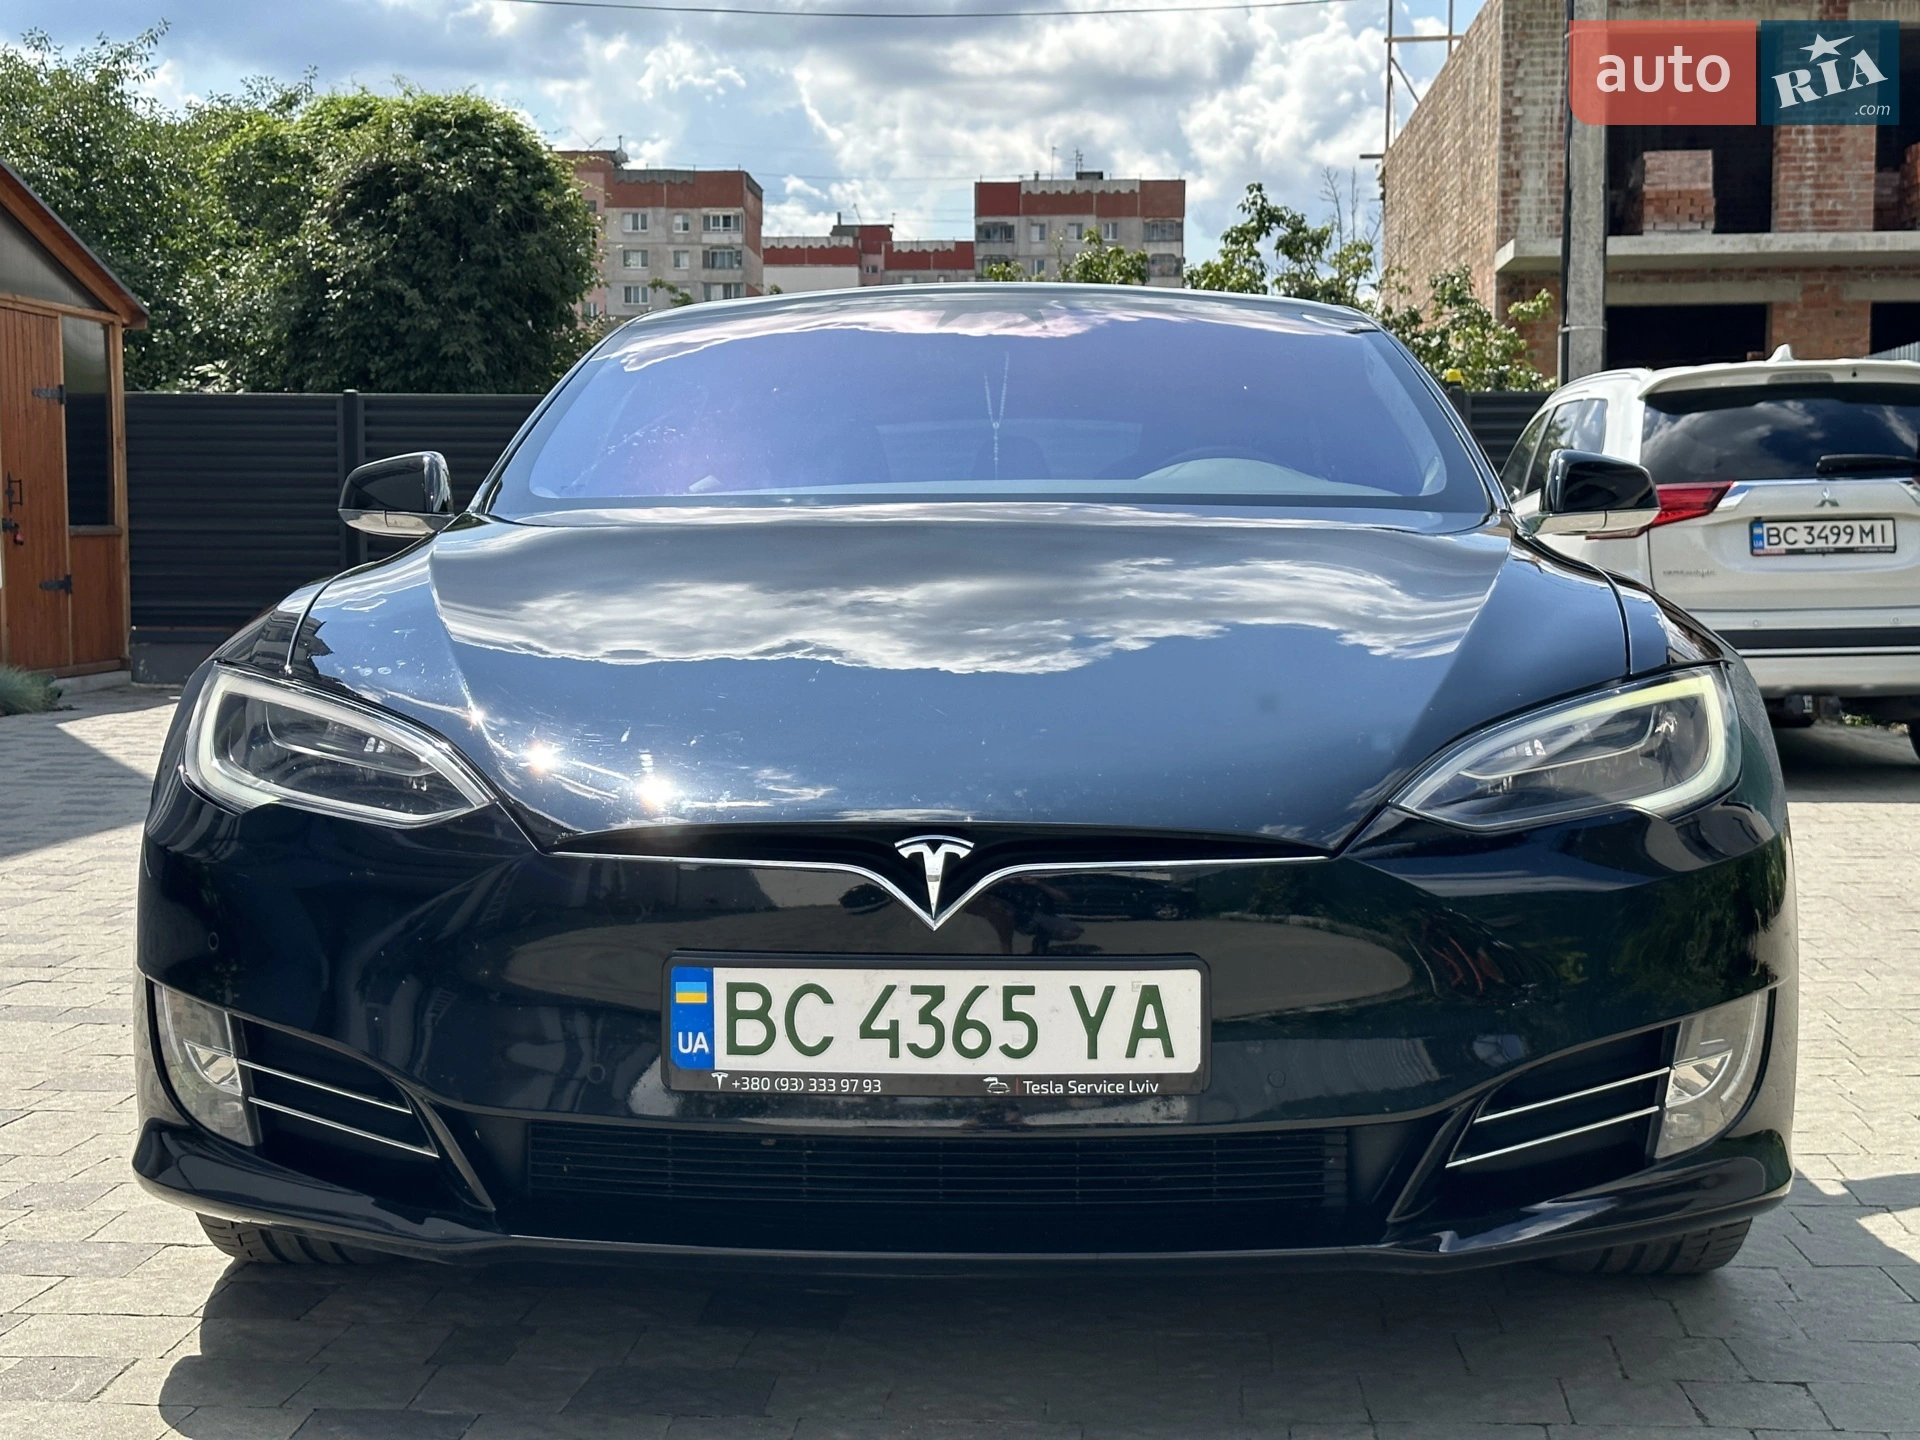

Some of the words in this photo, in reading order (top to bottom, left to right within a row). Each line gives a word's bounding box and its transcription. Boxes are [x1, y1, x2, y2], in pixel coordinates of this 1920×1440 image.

[1766, 526, 1798, 546] BC
[1803, 525, 1854, 545] 3499
[1859, 524, 1885, 544] MI
[726, 982, 834, 1057] BC
[859, 984, 1039, 1059] 4365
[1069, 984, 1175, 1060] YA
[677, 1031, 710, 1054] UA
[732, 1077, 771, 1091] +380
[774, 1077, 804, 1092] (93)
[808, 1078, 836, 1092] 333
[840, 1079, 859, 1093] 97
[862, 1079, 882, 1093] 93
[1023, 1080, 1064, 1094] Tesla
[1068, 1080, 1125, 1094] Service
[1129, 1080, 1159, 1094] Lviv
